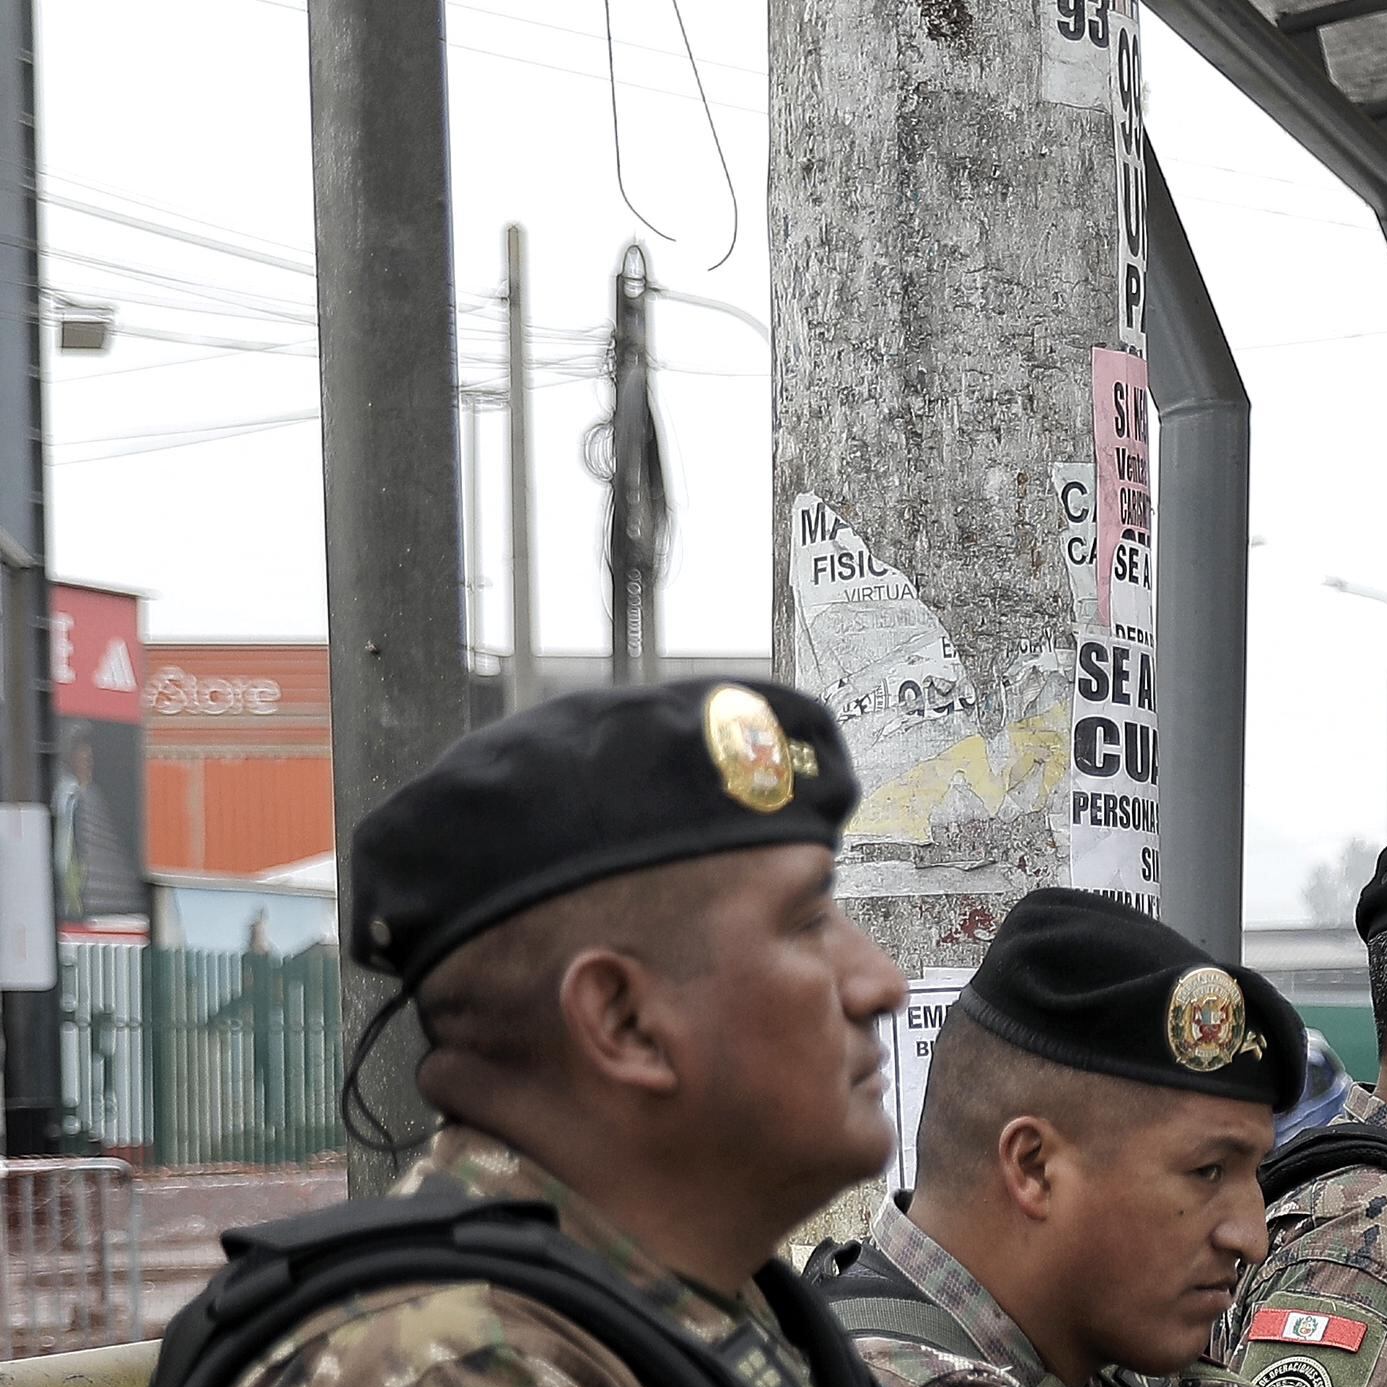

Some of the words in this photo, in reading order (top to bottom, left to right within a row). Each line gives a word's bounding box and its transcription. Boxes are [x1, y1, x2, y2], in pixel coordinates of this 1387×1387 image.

[1114, 544, 1139, 584] SE
[1078, 641, 1131, 705] SE
[908, 1005, 950, 1029] EM
